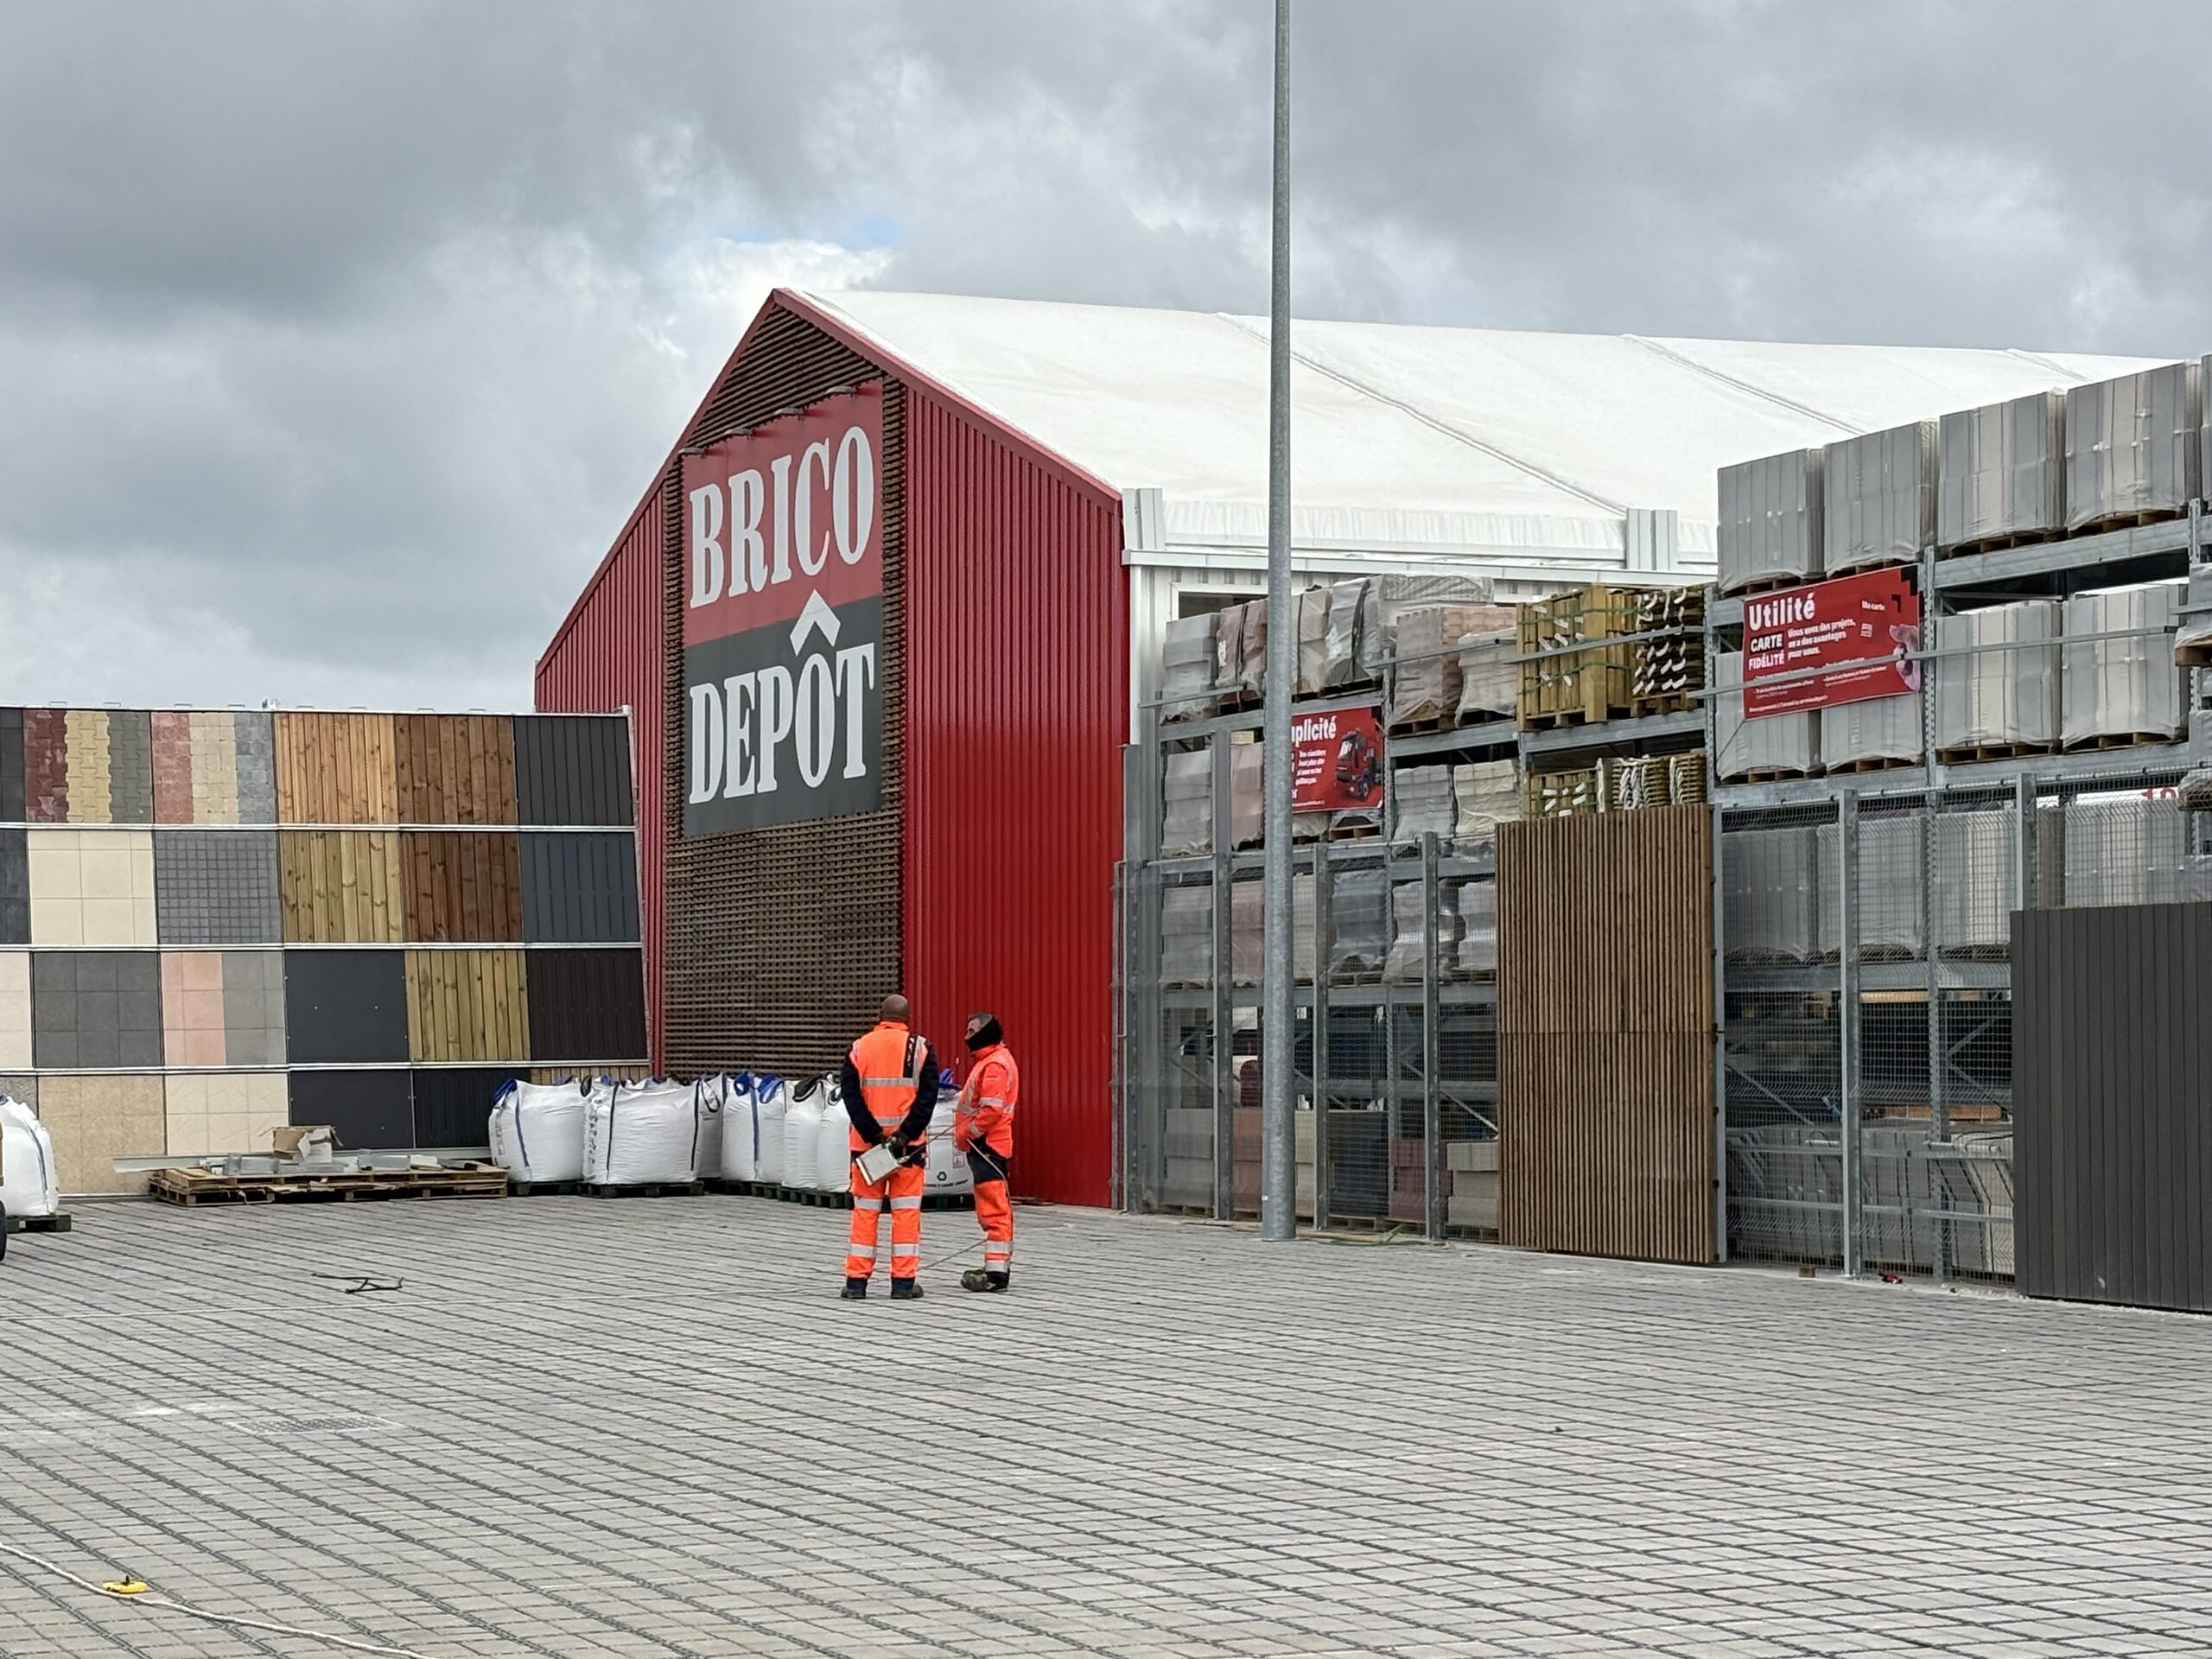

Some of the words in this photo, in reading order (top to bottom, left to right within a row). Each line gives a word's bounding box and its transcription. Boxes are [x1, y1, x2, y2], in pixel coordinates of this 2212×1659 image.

[690, 426, 874, 609] BRICO
[1749, 593, 1815, 630] Utilité
[1748, 650, 1785, 671] FIDÉLITÉ
[1750, 635, 1783, 652] CARTE
[689, 589, 874, 804] DEPÔT
